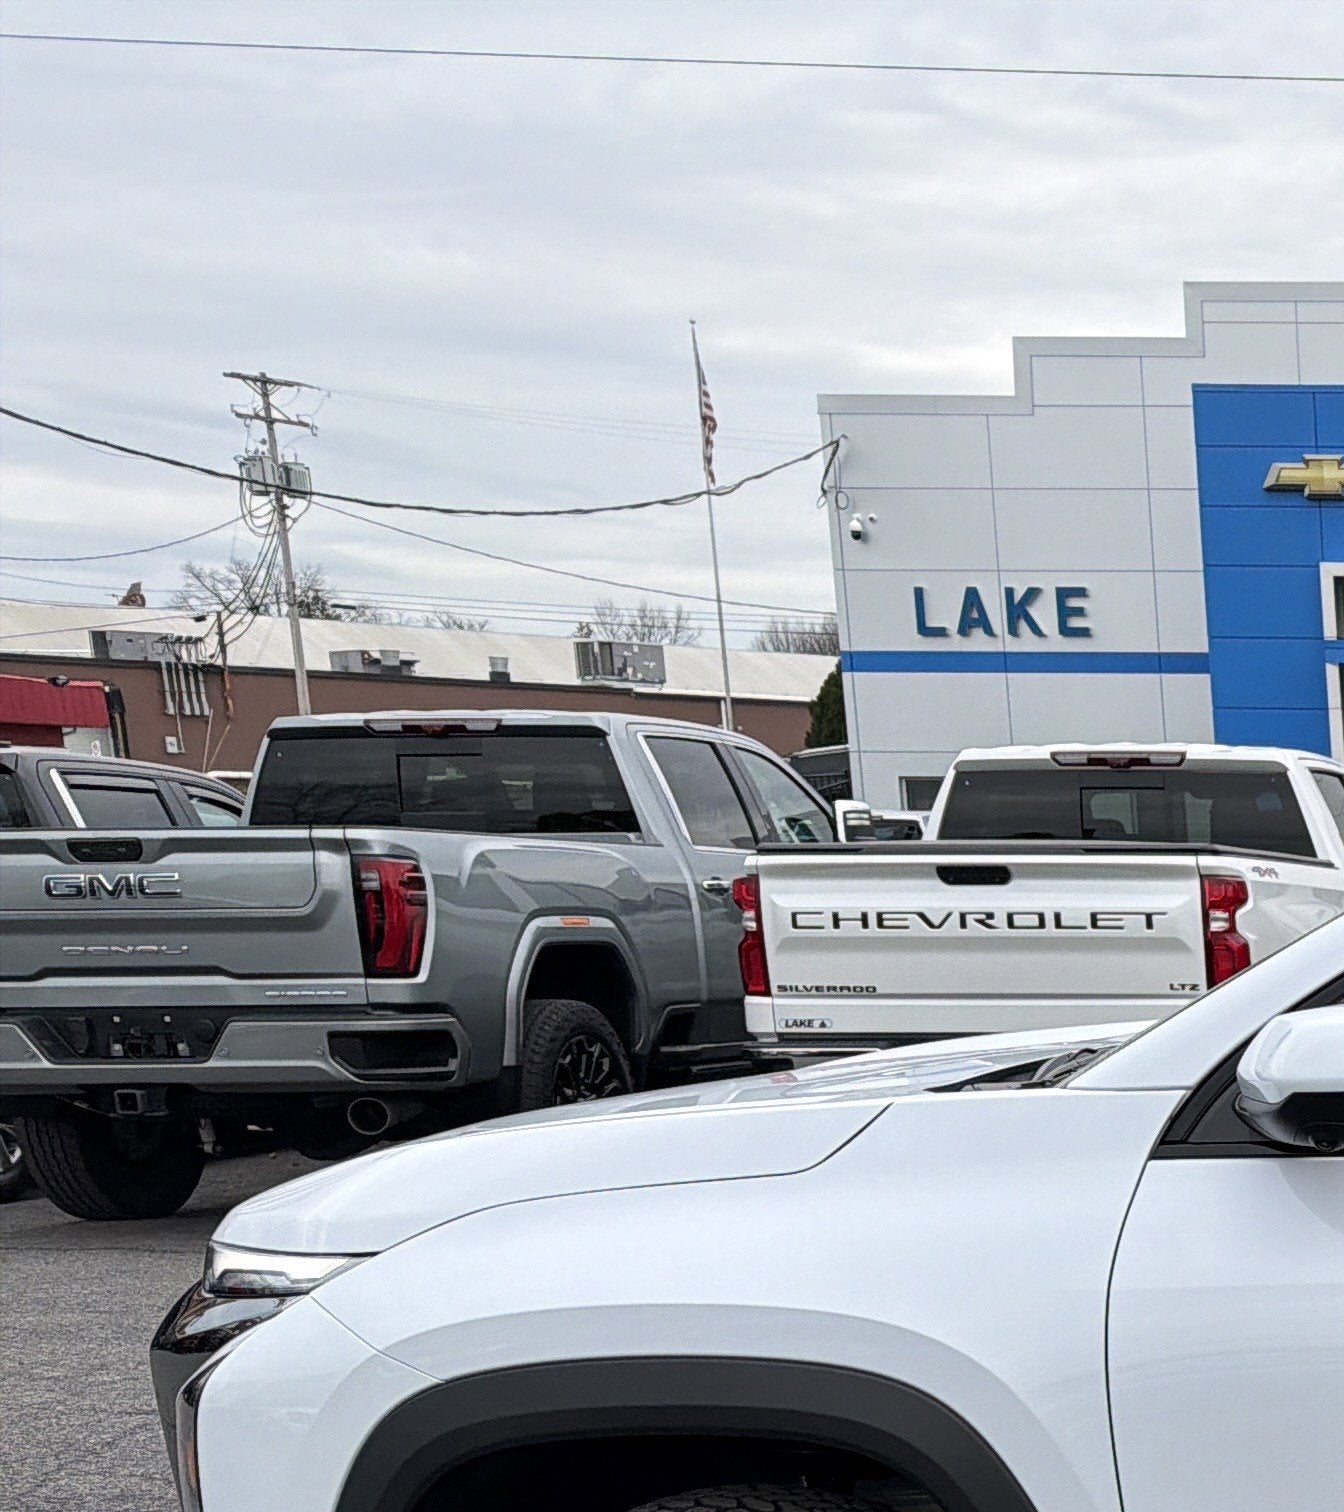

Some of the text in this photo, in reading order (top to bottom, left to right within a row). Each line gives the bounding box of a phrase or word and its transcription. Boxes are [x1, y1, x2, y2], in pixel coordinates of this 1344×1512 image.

[913, 586, 1092, 638] LAKE
[43, 872, 182, 900] GMC
[790, 909, 1168, 932] CHEVROLET
[776, 984, 877, 994] SILVERADO
[1169, 982, 1200, 992] LTZ
[784, 1018, 815, 1029] LAKE
